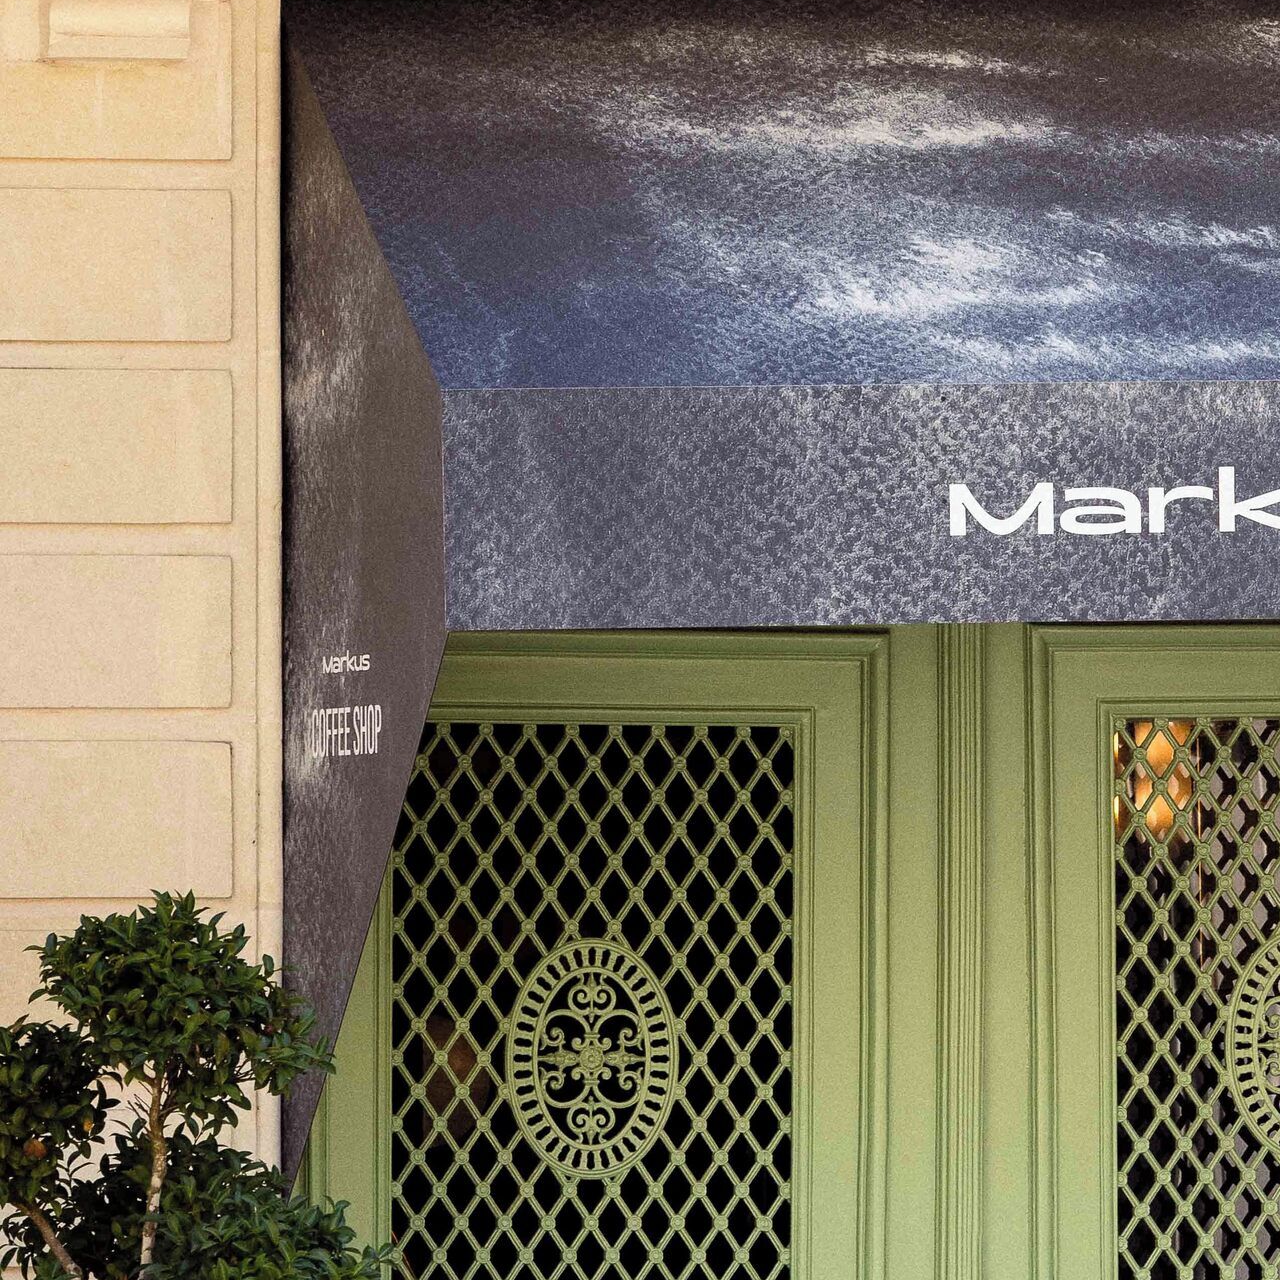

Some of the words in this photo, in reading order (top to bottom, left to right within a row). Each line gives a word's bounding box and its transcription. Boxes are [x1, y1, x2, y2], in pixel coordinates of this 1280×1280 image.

[322, 650, 371, 674] Markus
[312, 707, 351, 757] COFFEE
[353, 704, 382, 755] SHOP
